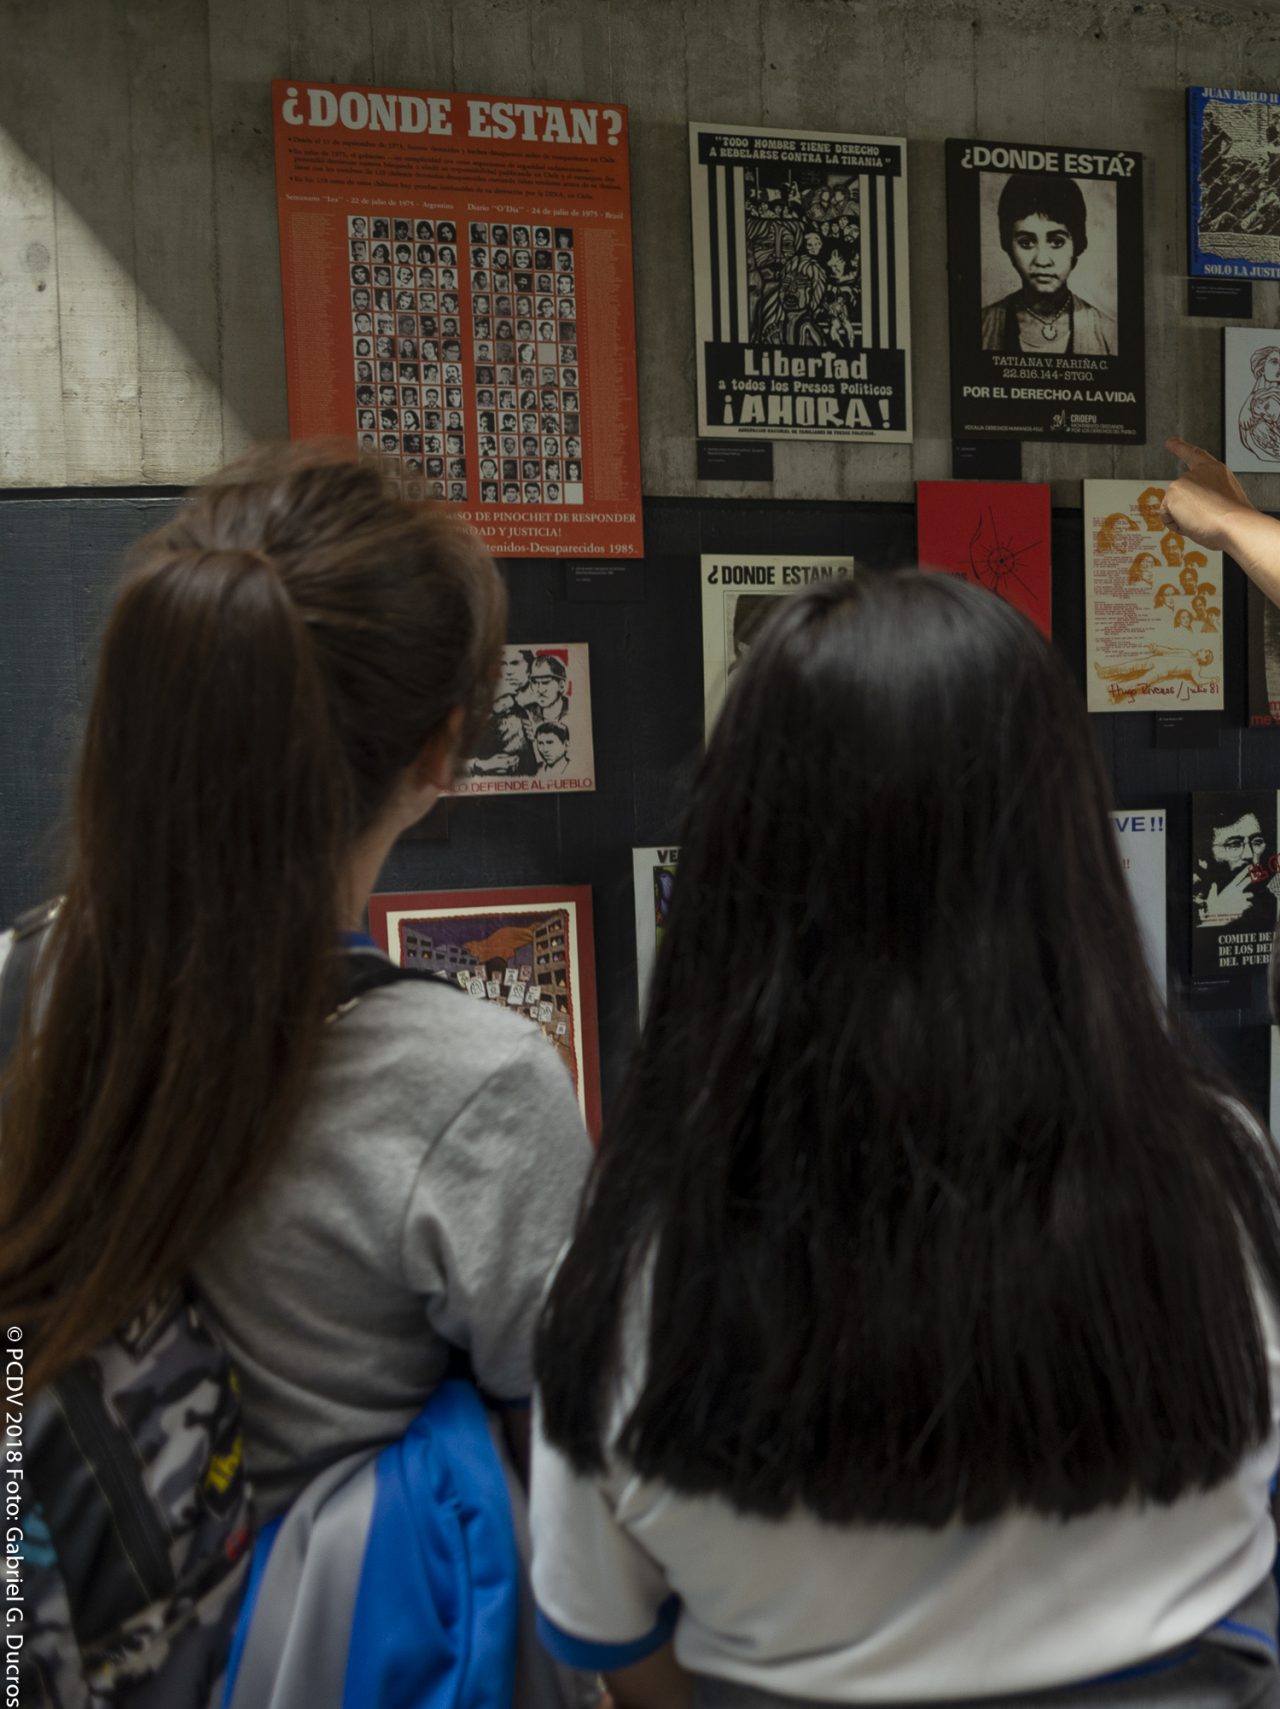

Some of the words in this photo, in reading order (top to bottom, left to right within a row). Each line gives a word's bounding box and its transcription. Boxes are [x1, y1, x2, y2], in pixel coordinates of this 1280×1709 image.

[1202, 87, 1232, 101] JUAN
[1233, 90, 1267, 103] PABLO
[1269, 92, 1279, 103] II
[281, 86, 454, 136] ¿DONDE
[467, 99, 623, 147] ESTAN?
[754, 138, 796, 150] HOMBRE
[800, 141, 831, 153] TIENE
[835, 144, 880, 155] DERECHO
[709, 147, 718, 157] A
[720, 148, 779, 160] REBELARSE
[781, 152, 822, 163] CONTRA
[825, 155, 840, 164] LA
[961, 146, 1059, 172] ¿DONDE
[1064, 152, 1135, 177] ESTÁ?
[467, 203, 490, 212] Diario
[542, 207, 551, 216] de
[553, 207, 569, 218] julio
[570, 208, 579, 217] de
[1204, 264, 1233, 276] SOLO
[1234, 265, 1248, 276] LA
[992, 355, 1044, 368] TATIANA
[1056, 357, 1098, 370] FARIÑA
[718, 379, 727, 390] a
[731, 379, 766, 391] todos
[771, 380, 789, 392] los
[793, 380, 835, 394] Presos
[840, 382, 893, 396] Politicos
[963, 386, 990, 398] POR
[993, 387, 1008, 399] EL
[1011, 388, 1071, 401] DERECHO
[1073, 391, 1083, 401] A
[1086, 391, 1103, 402] LA
[1102, 392, 1137, 403] VIDA
[475, 511, 491, 522] DE
[493, 512, 550, 522] PINOCHET
[554, 512, 570, 523] DE
[572, 513, 637, 524] RESPONDER
[498, 527, 507, 537] Y
[507, 527, 562, 539] JUSTICIA!
[707, 565, 775, 585] ¿DONDE
[471, 780, 529, 793] DEFIENDE
[531, 780, 545, 791] AL
[546, 778, 593, 790] PUEBLO
[1217, 932, 1257, 945] COMITE
[1258, 931, 1272, 942] DE
[1218, 946, 1232, 956] DE
[1234, 944, 1254, 955] LOS
[1219, 956, 1239, 968] DEL
